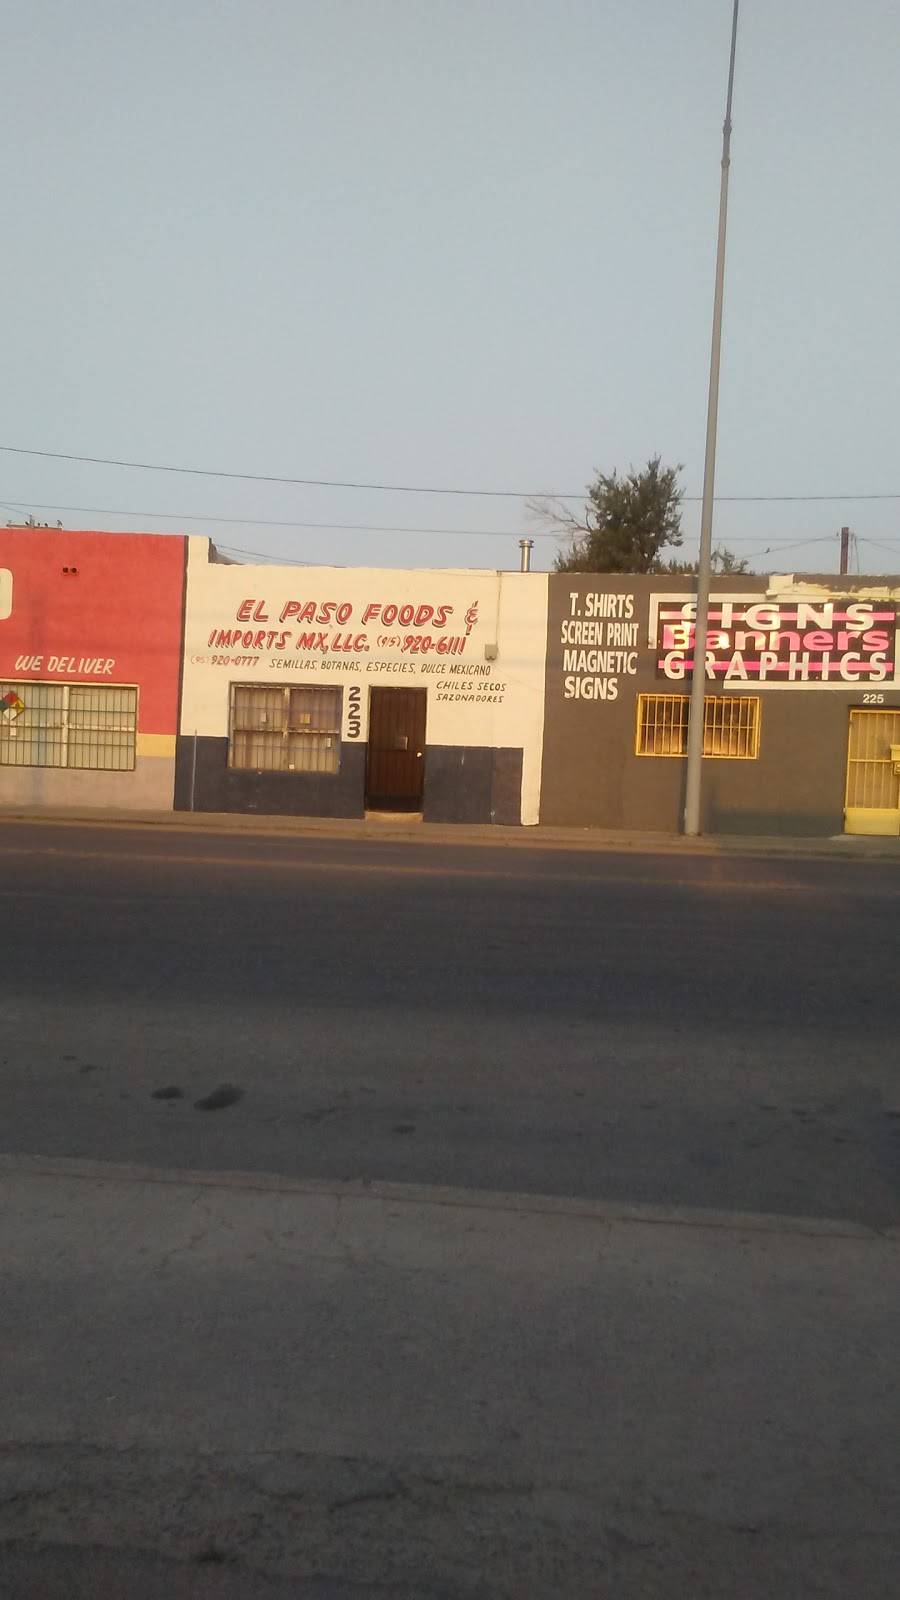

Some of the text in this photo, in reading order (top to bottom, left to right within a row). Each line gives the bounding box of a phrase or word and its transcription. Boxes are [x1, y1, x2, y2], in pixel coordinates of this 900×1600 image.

[237, 599, 479, 636] EL PASO FOODS &
[570, 592, 634, 619] T. SHIRTS
[681, 602, 874, 631] SIGNS
[208, 629, 291, 650] IMPORTS
[401, 634, 467, 656] 920-6111
[560, 620, 639, 647] SCREEN PRINT
[663, 624, 889, 650] Banners
[15, 655, 115, 675] WE DELIVER
[211, 655, 260, 667] 920-0777
[269, 659, 491, 676] SEMILLAS, BOTANAS, ESPECIES, DULCE MEXICANO
[563, 650, 638, 674] MAGNETIC
[664, 650, 887, 681] GRAPHICS
[436, 681, 507, 692] CHILES SECOS
[436, 693, 504, 703] SAZONADORES
[564, 676, 618, 700] SIGNS
[862, 693, 885, 704] 225
[347, 686, 361, 739] 223
